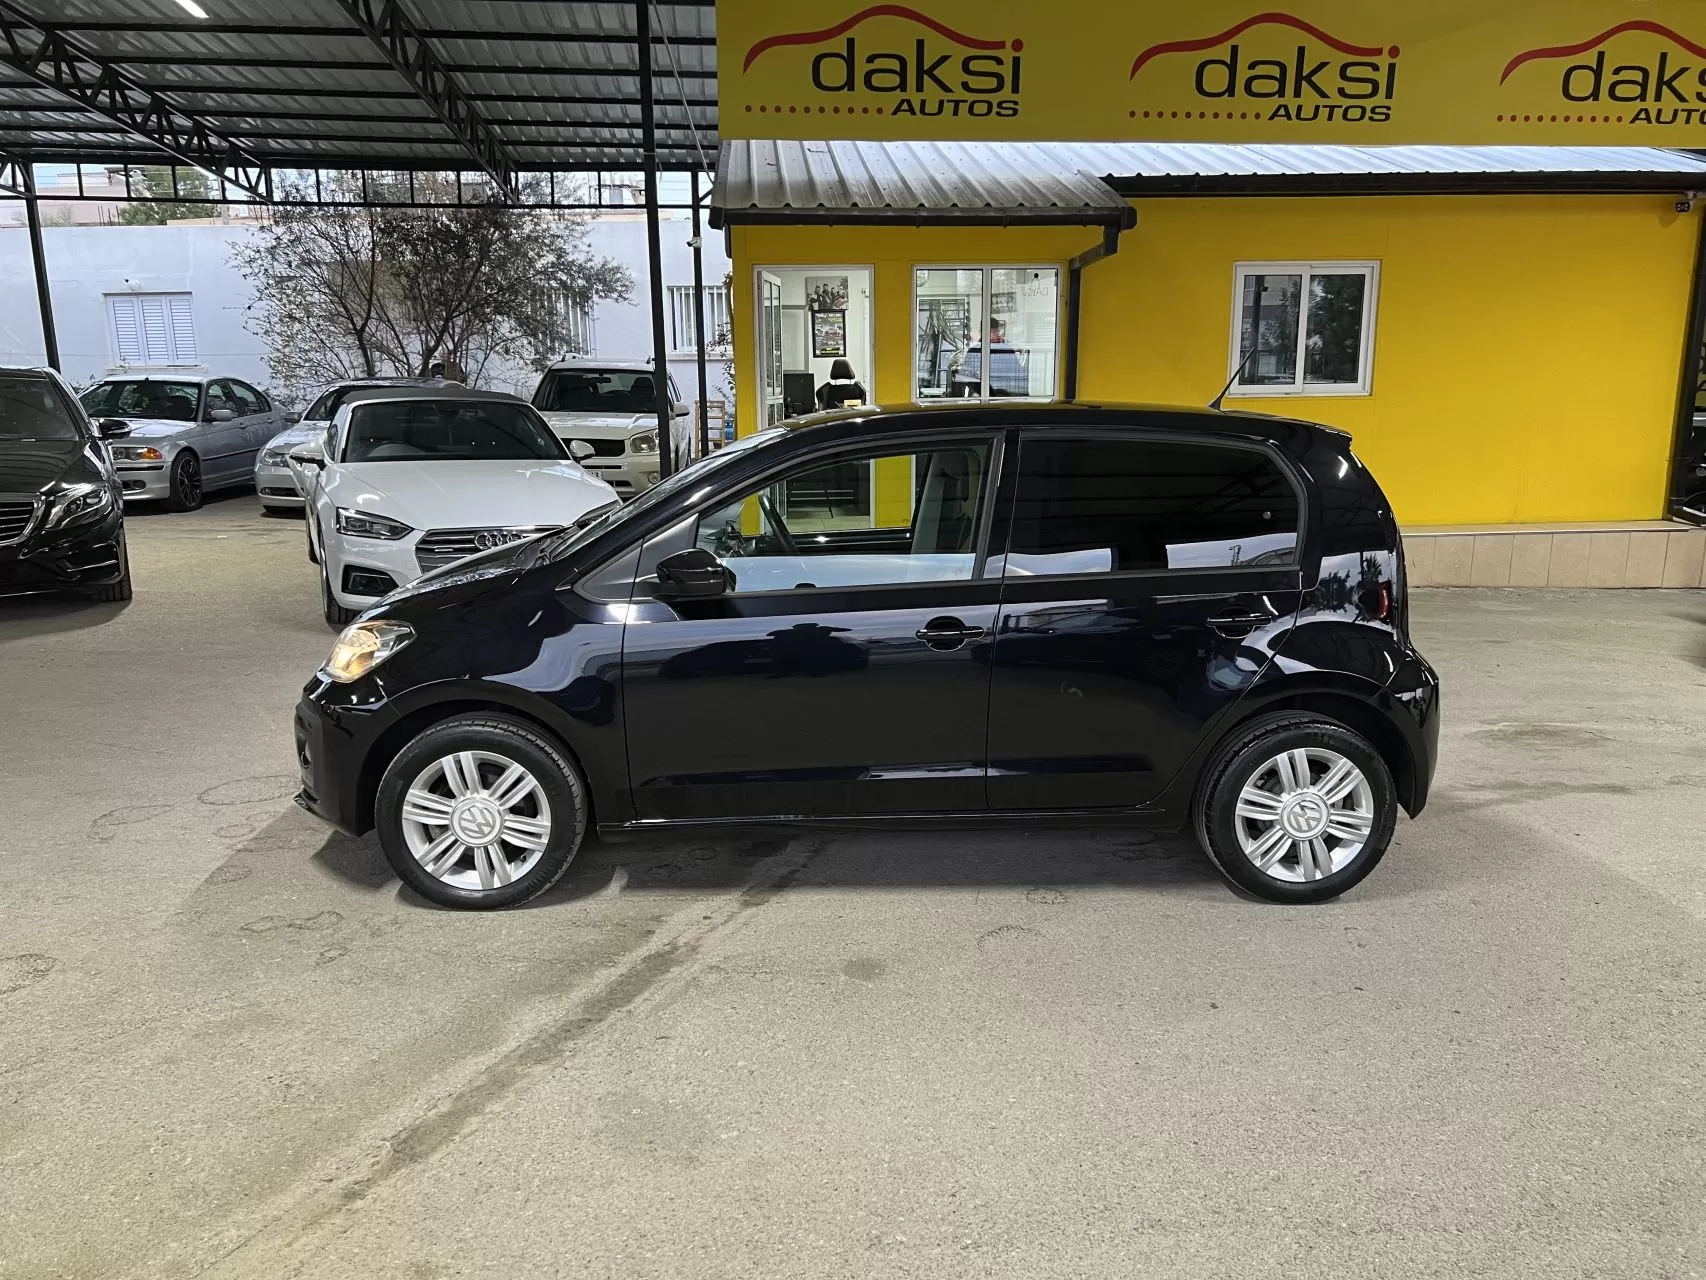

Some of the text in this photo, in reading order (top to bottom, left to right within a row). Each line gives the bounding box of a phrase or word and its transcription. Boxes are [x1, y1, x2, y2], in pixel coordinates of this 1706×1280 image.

[811, 37, 1024, 95] daksi
[1194, 44, 1400, 100] daksi
[1561, 50, 1706, 103] dak
[890, 98, 1019, 117] AUTOS
[1267, 103, 1391, 123] AUTOS
[1629, 107, 1706, 125] AUT
